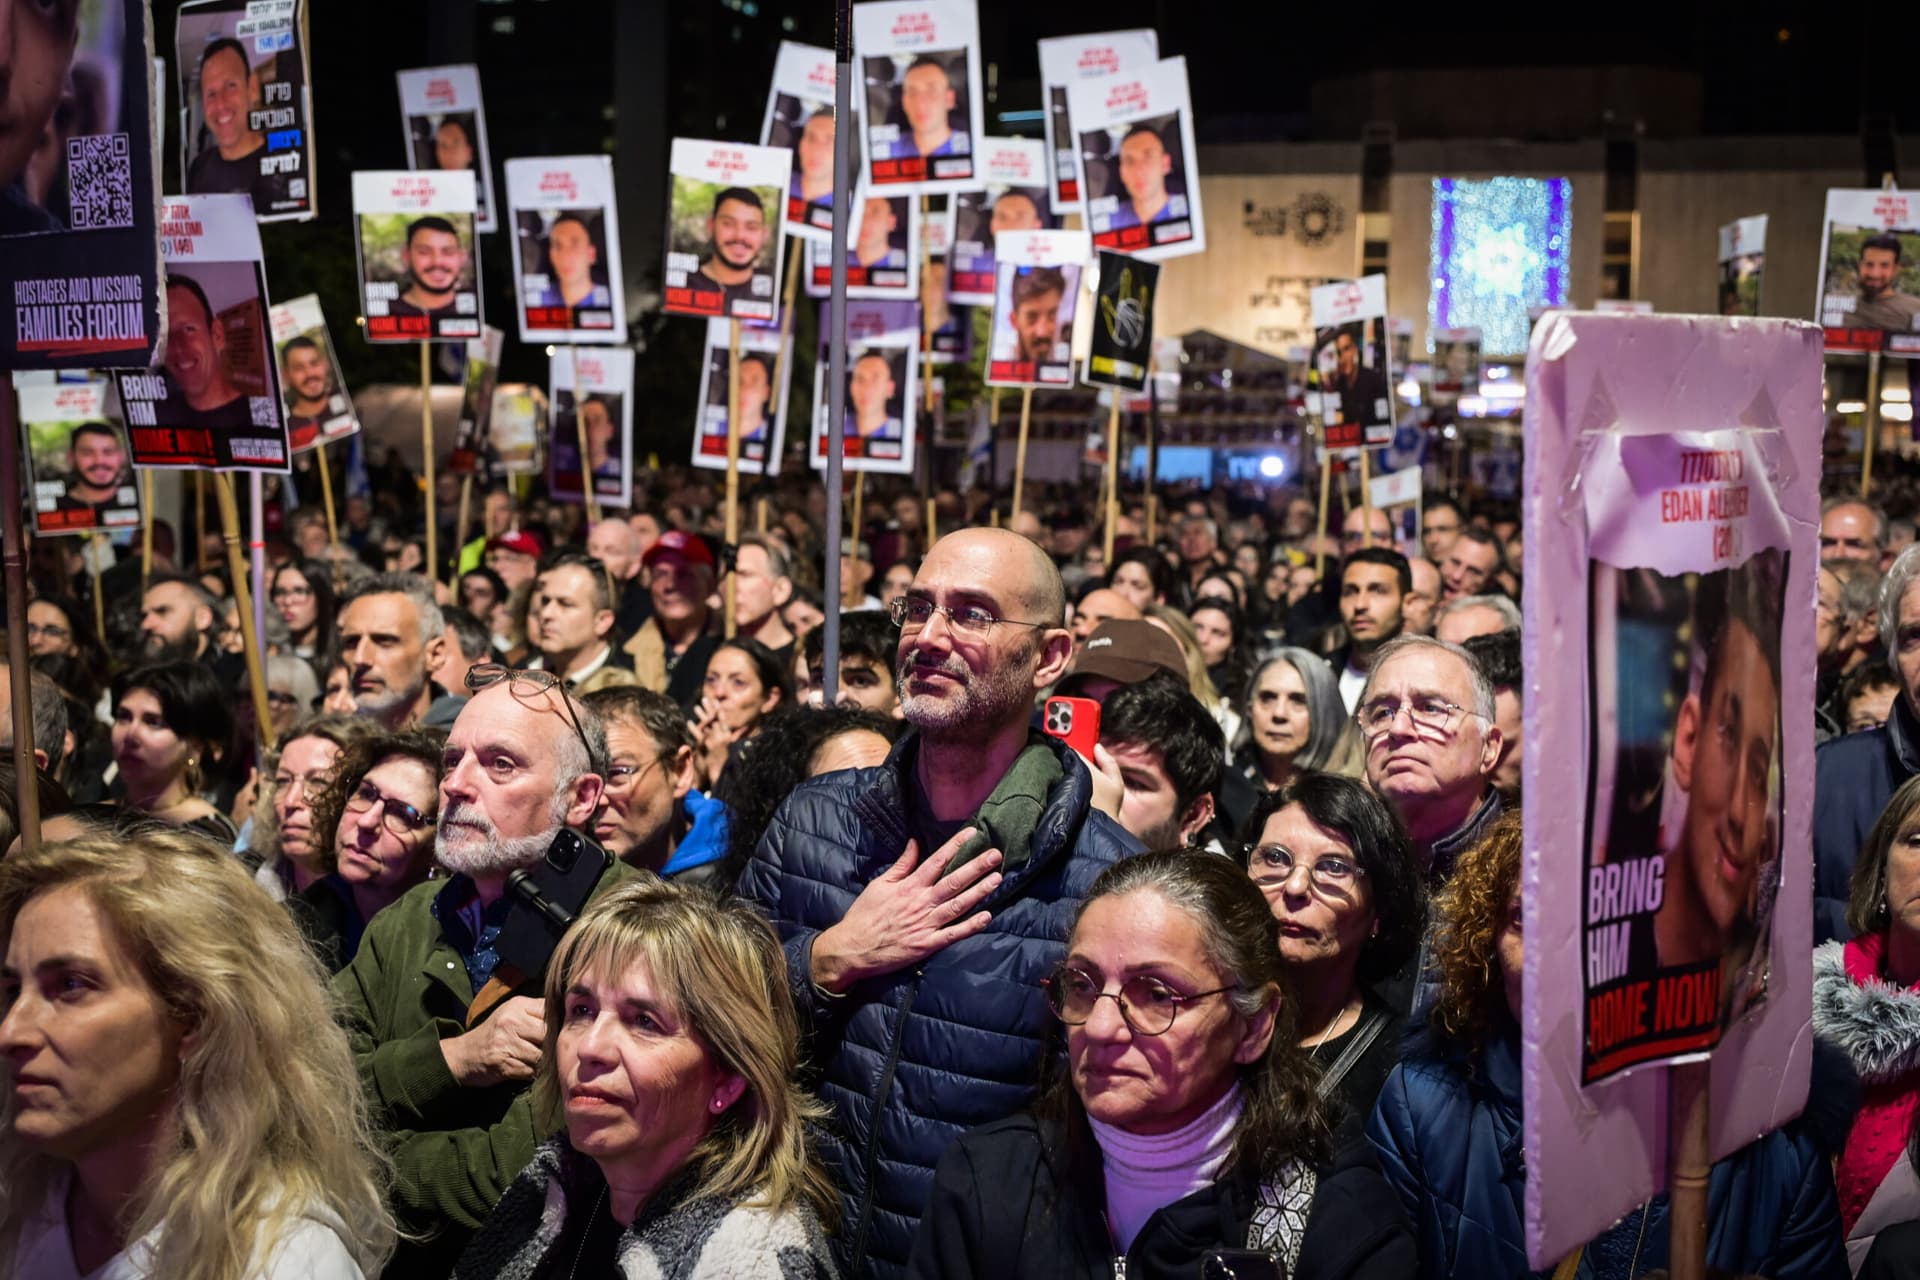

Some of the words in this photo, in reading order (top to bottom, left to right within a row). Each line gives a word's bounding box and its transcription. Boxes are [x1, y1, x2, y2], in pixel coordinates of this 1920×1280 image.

[161, 221, 203, 237] AHALOMI
[14, 278, 67, 305] HOSTAGES
[68, 277, 91, 303] AND
[91, 274, 143, 302] MISSING
[16, 303, 84, 343] FAMILIES
[85, 301, 144, 341] FORUM
[121, 375, 168, 401] BRING
[126, 401, 158, 426] HIM
[1661, 489, 1702, 524] EDAN
[1588, 855, 1665, 926] BRING
[1588, 920, 1632, 989] HIM
[1589, 981, 1650, 1056] HOME
[1654, 967, 1719, 1033] NOW
